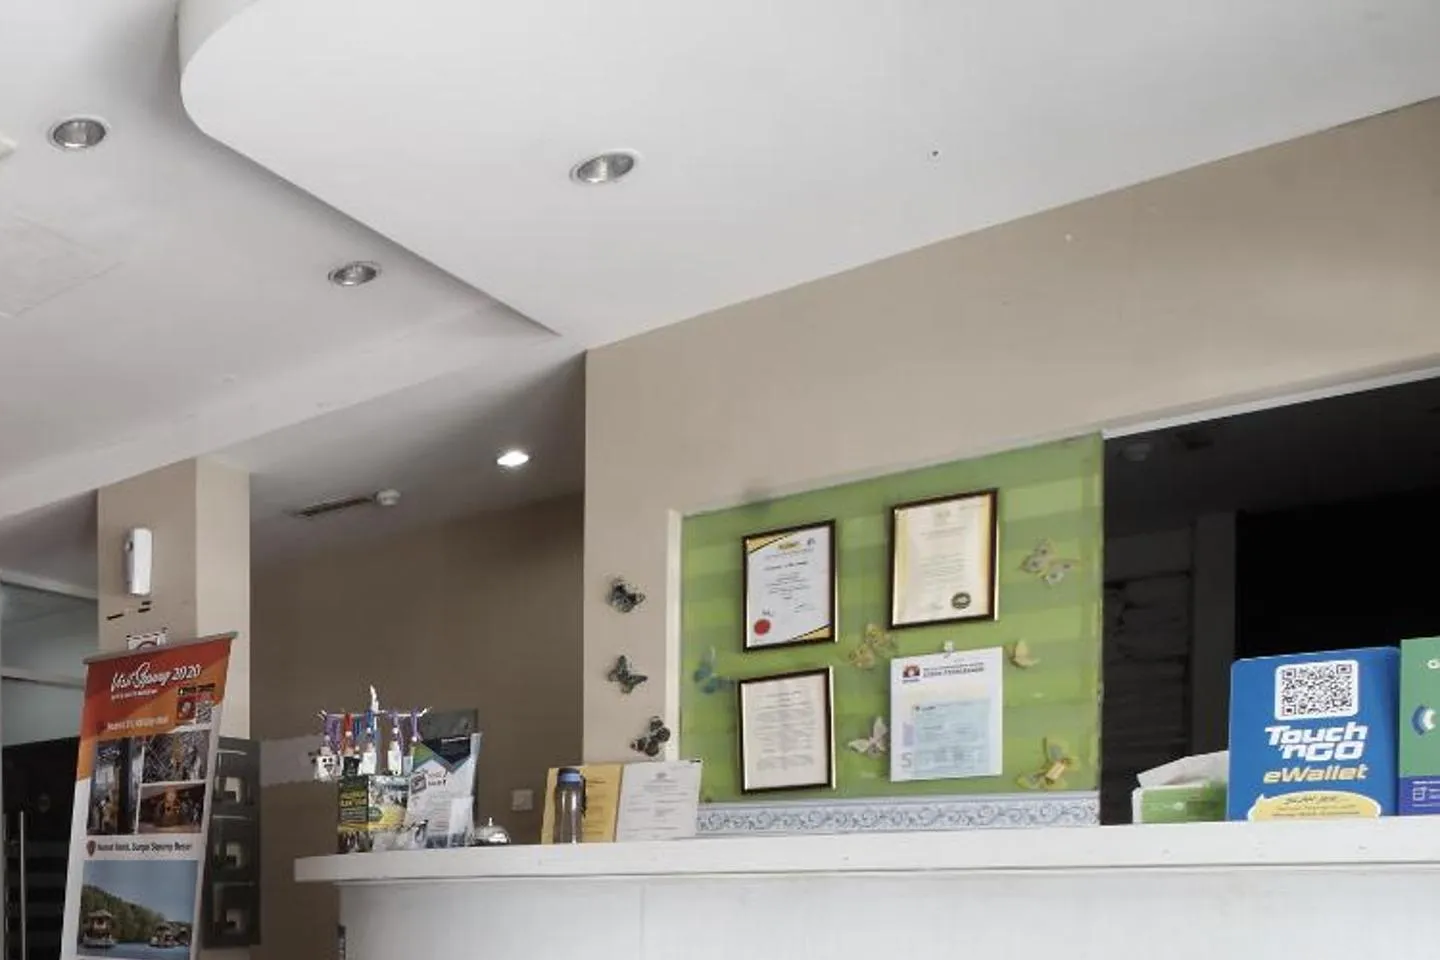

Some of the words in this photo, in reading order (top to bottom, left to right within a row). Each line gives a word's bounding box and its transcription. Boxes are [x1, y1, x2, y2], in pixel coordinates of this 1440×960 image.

[172, 664, 201, 681] 2020
[1264, 722, 1368, 746] Touch
[1263, 764, 1368, 784] eWallet
